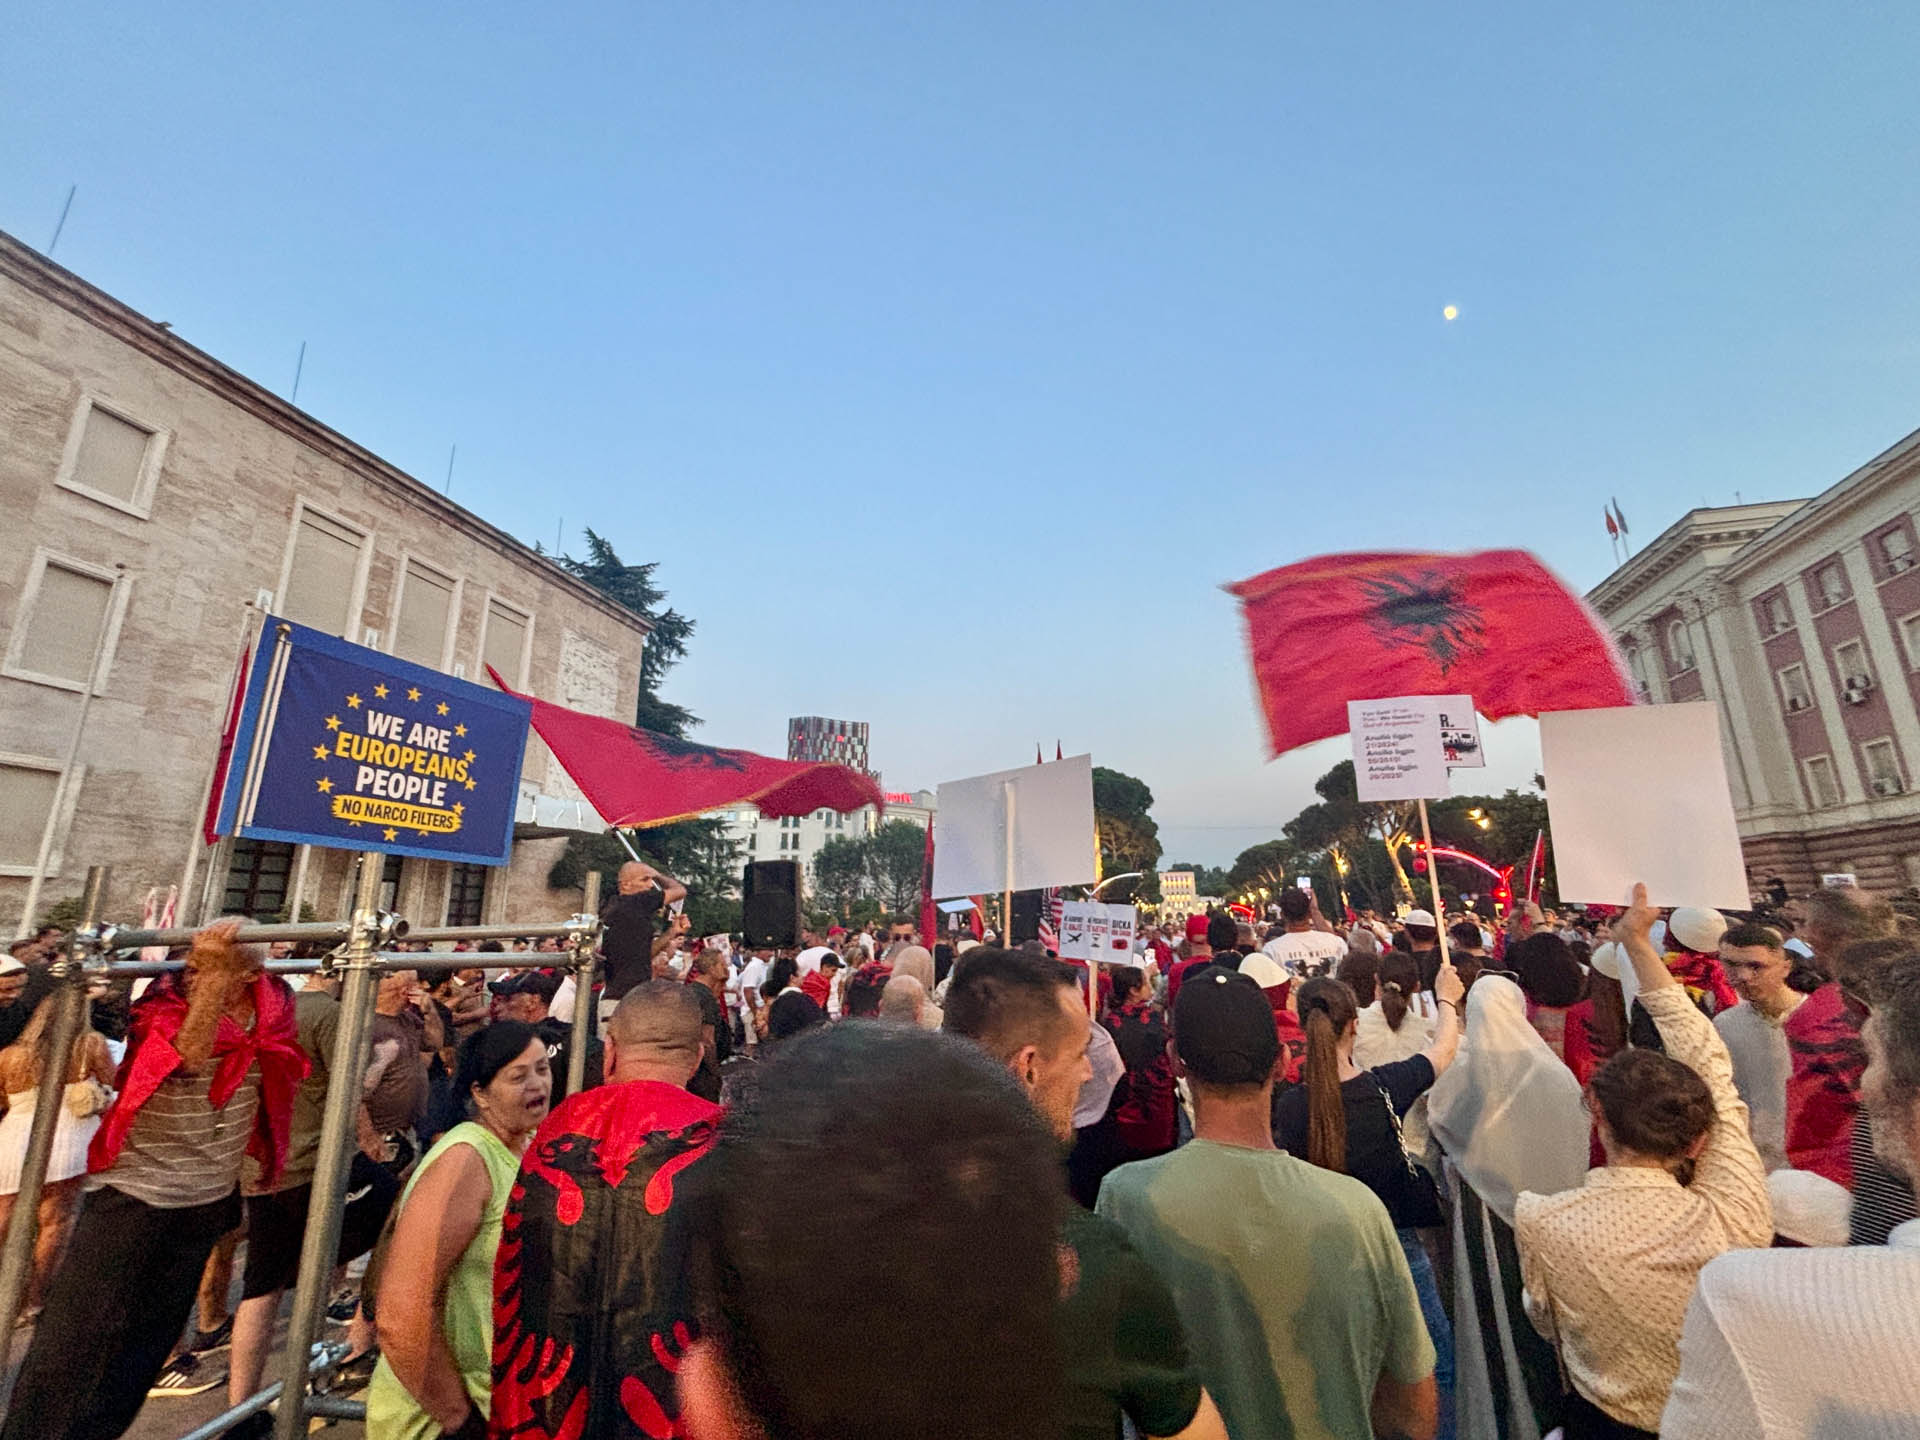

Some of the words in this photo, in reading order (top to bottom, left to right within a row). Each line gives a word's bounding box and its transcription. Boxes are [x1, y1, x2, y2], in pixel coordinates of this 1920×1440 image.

[368, 710, 405, 741] WE
[406, 723, 452, 753] ARE
[335, 731, 469, 782] EUROPEANS
[355, 765, 447, 806] PEOPLE
[341, 799, 362, 815] NO
[364, 802, 408, 822] NARCO
[411, 810, 453, 829] FILTERS
